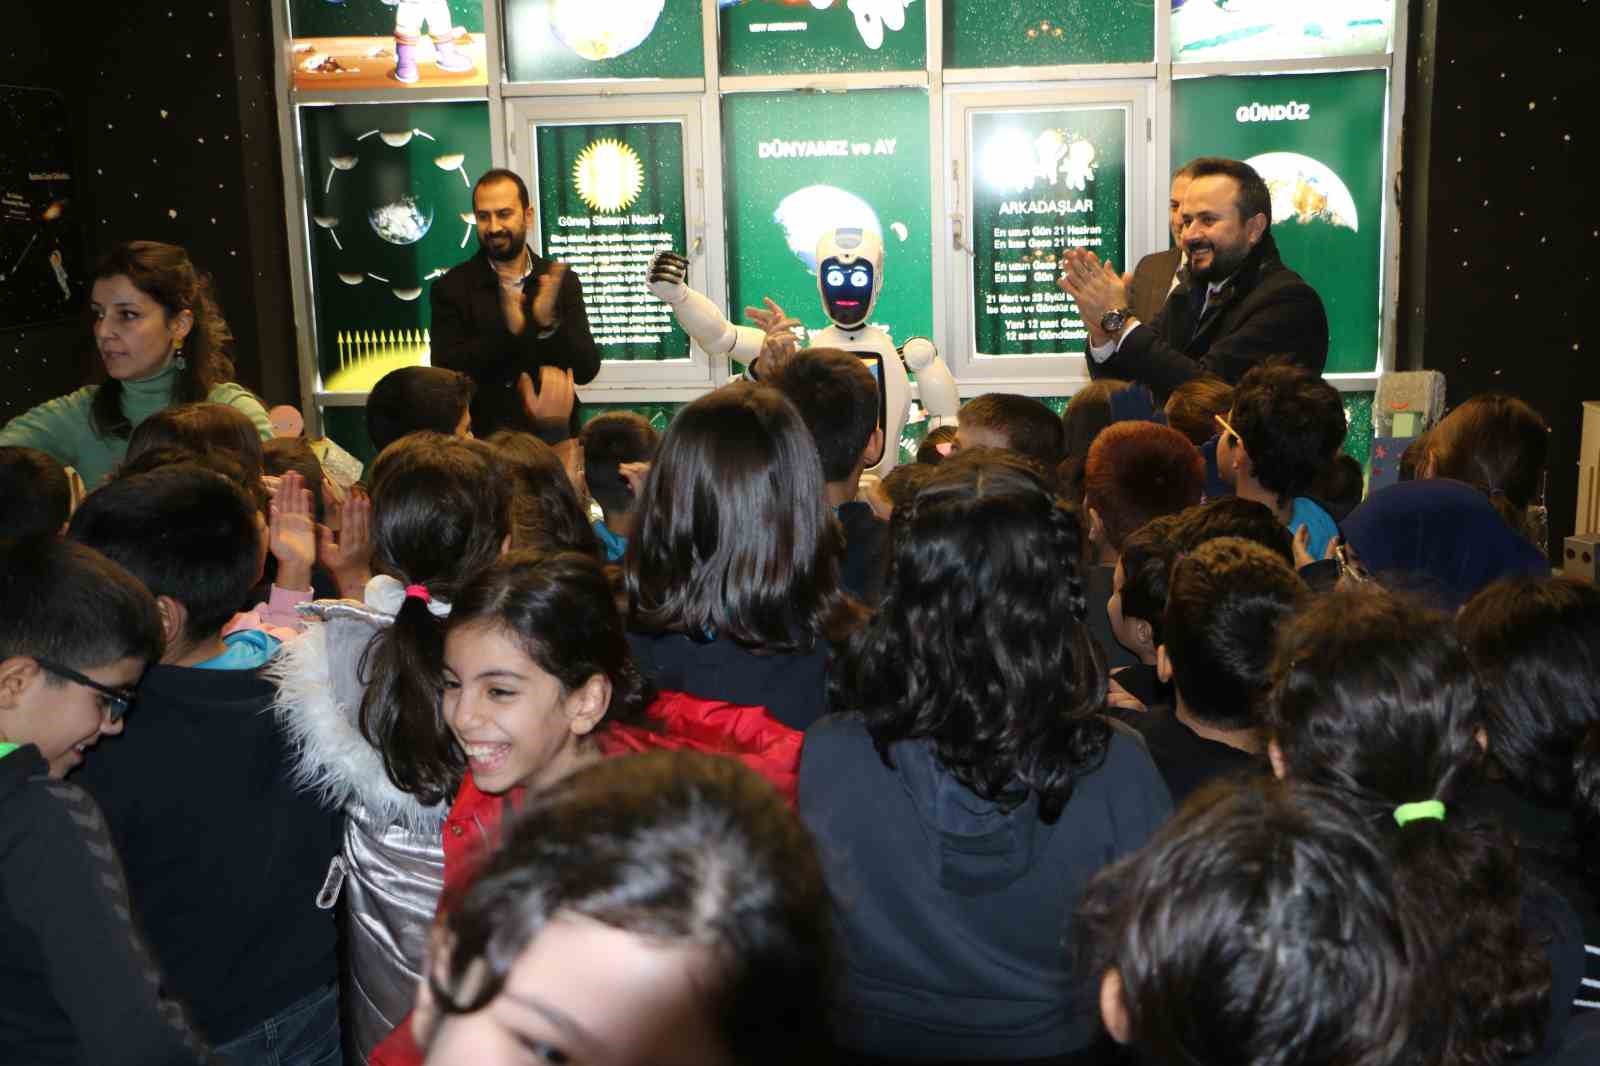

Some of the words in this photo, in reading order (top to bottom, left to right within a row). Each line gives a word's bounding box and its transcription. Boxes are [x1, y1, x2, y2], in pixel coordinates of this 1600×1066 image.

[1236, 101, 1310, 122] GÜNDÜZ
[759, 139, 848, 158] DÜNYAMIZ
[851, 142, 871, 156] ve
[873, 138, 896, 156] AY
[999, 199, 1093, 216] ARKADAŞLAR
[558, 216, 591, 228] Güneş
[631, 213, 665, 225] Nedir?
[994, 228, 1006, 237] En
[1032, 226, 1052, 236] Gün
[1053, 226, 1065, 235] 21
[1067, 226, 1102, 235] Haziran
[994, 239, 1006, 249] En
[1054, 238, 1065, 247] 21
[1067, 237, 1102, 246] Haziran
[994, 262, 1007, 271] En
[995, 274, 1007, 283] En
[1033, 271, 1054, 282] Gün
[986, 294, 996, 303] 21
[1024, 305, 1034, 313] ve
[1028, 319, 1038, 328] 12
[1006, 331, 1016, 340] 12
